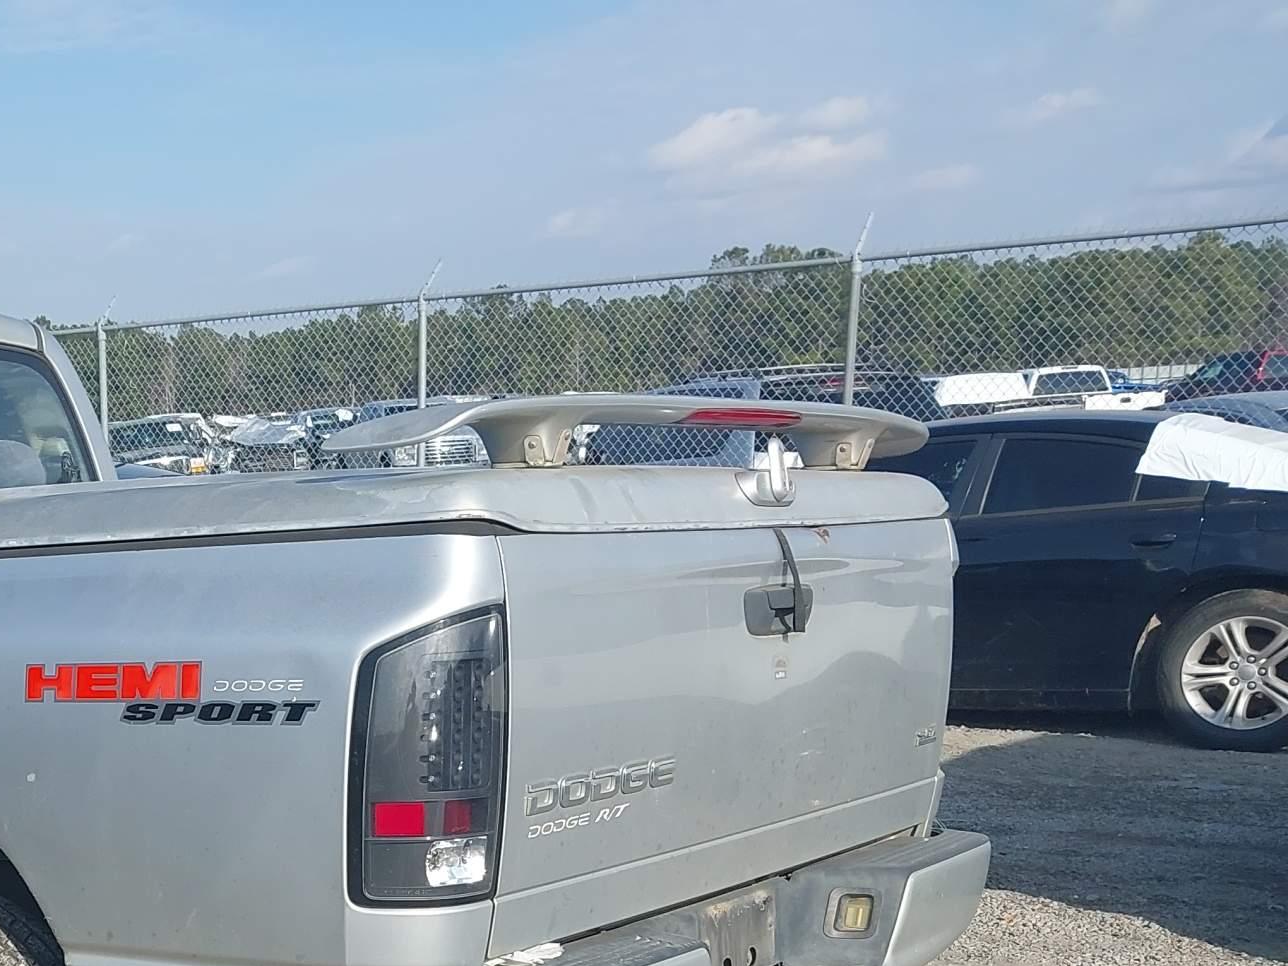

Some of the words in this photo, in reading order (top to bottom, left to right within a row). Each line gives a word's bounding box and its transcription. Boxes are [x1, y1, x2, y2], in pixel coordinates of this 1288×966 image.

[25, 661, 202, 702] HEMI
[213, 679, 305, 692] DODGE
[121, 700, 320, 725] SPORT
[524, 754, 677, 817] DODGE
[528, 812, 591, 839] DODGE
[595, 803, 631, 823] R/T
